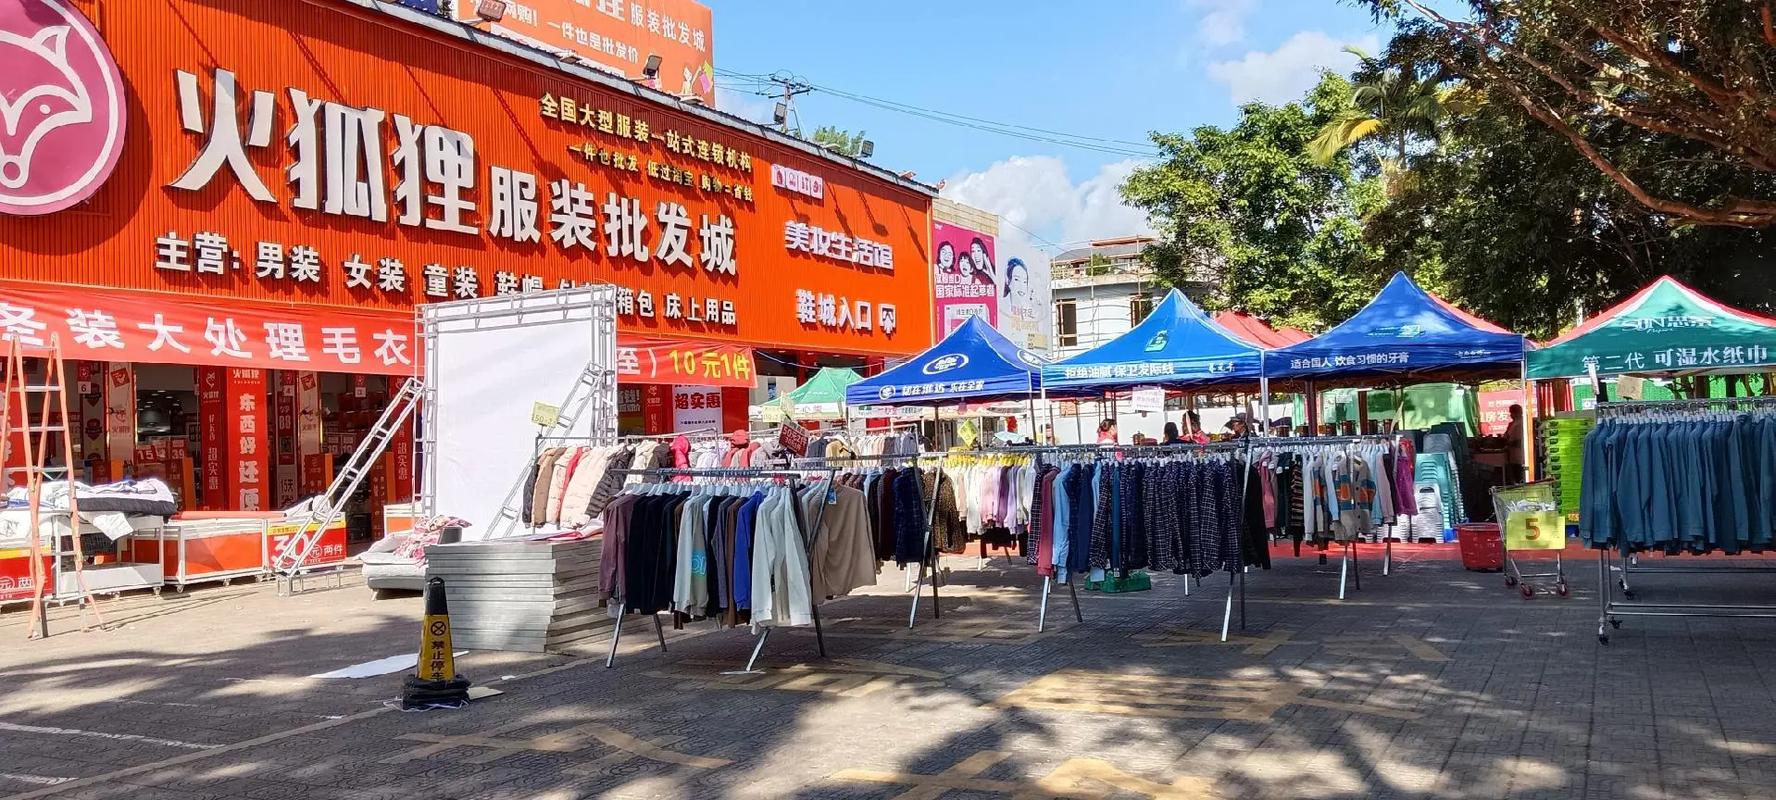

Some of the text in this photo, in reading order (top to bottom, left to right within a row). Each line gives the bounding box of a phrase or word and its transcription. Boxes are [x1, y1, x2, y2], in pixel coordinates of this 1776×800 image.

[547, 21, 639, 63] 一件也是批发价
[540, 92, 753, 173] 全国大型服装一站式连锁机构
[163, 68, 737, 276] 火狐狸 服装批发城
[569, 142, 639, 172] 一件也批发
[784, 220, 893, 270] 美妆生活馆
[256, 241, 321, 283] 男装
[343, 254, 406, 293] 女装
[423, 264, 478, 299] 童装
[615, 288, 655, 318] 箱包
[665, 292, 737, 325] 床上用品
[795, 289, 873, 331] 鞋城入口
[1114, 362, 1176, 377] 保卫发际线
[1290, 352, 1410, 369] 适合国人 饮食习惯的牙膏
[1582, 344, 1768, 373] 第二代 可湿水纸巾
[81, 384, 87, 392] 6
[675, 392, 721, 409] 超实惠
[1525, 518, 1541, 540] 5
